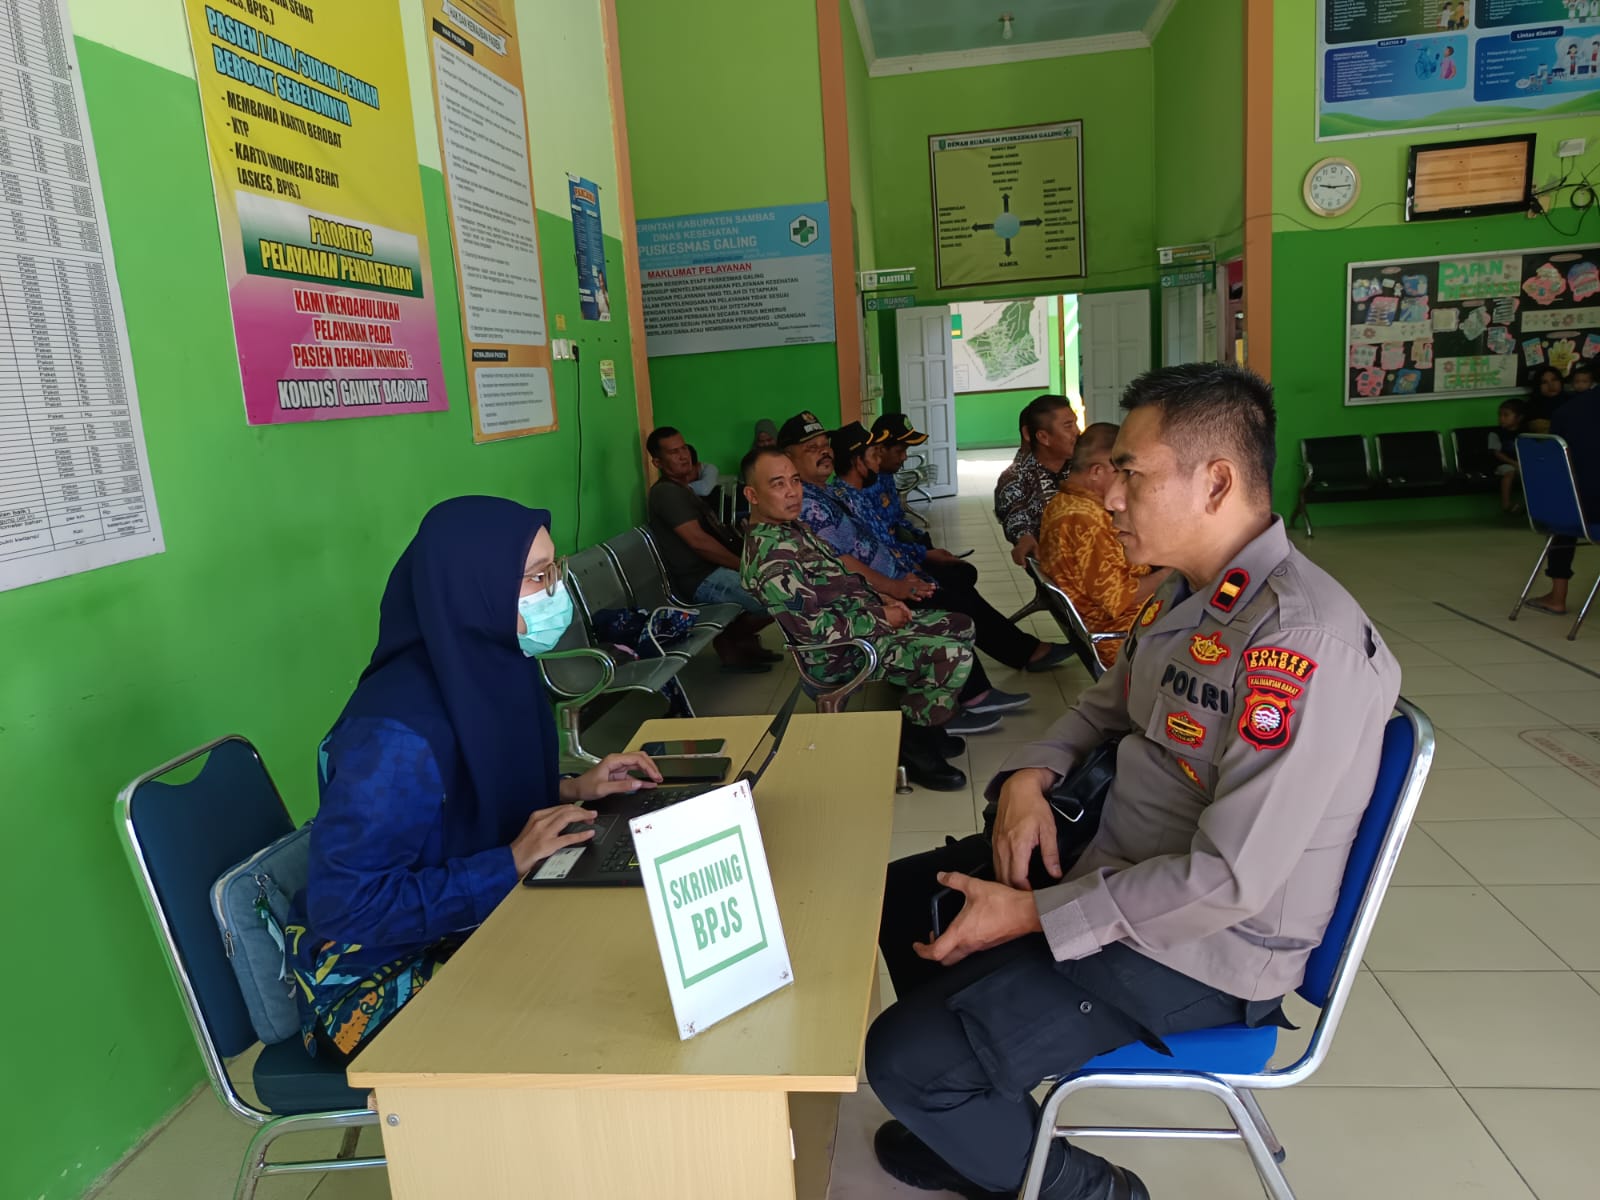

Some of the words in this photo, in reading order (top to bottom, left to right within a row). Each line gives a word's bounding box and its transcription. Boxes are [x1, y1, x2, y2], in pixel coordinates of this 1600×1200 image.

[289, 0, 314, 24] SEHAT
[205, 4, 260, 56] PASIEN
[338, 70, 380, 110] PERNAH
[212, 43, 276, 96] BEROBAT
[276, 72, 352, 127] SEBELUMNYA
[227, 91, 279, 125] MEMBAWA
[280, 110, 306, 135] KARTU
[306, 122, 342, 148] BEROBAT
[231, 116, 249, 137] KTP
[235, 142, 268, 167] KARTU
[267, 152, 314, 182] INDONESIA
[316, 168, 339, 188] SEHAT
[676, 216, 732, 228] KABUPATEN
[735, 212, 775, 224] SAMBAS
[308, 215, 374, 256] PRIORITAS
[639, 240, 711, 257] PUSKESMAS
[714, 236, 758, 250] GALING
[653, 231, 681, 242] DINAS
[683, 227, 738, 239] KESEHATAN
[260, 239, 338, 280] PELAYANAN
[340, 254, 413, 290] PENDAFTARAN
[648, 266, 696, 279] MAKLUMAT
[699, 263, 752, 274] PELAYANAN
[294, 290, 324, 313] KAMI
[326, 294, 400, 320] MENDAHULUKAN
[314, 320, 368, 342] PELAYANAN
[368, 324, 392, 344] PADA
[293, 346, 332, 368] PASIEN
[334, 348, 373, 368] DENGAN
[277, 380, 340, 410] KONDISI
[340, 380, 380, 406] GAWAT
[382, 380, 430, 404] DARURAT
[1250, 658, 1304, 676] SAMBAS
[1252, 650, 1308, 669] POLRES
[1161, 664, 1229, 714] POLRI
[1250, 678, 1281, 688] KALIMANTAN
[1281, 683, 1299, 695] BARAT
[669, 854, 743, 910] SKRINING
[690, 896, 743, 950] BPJS
